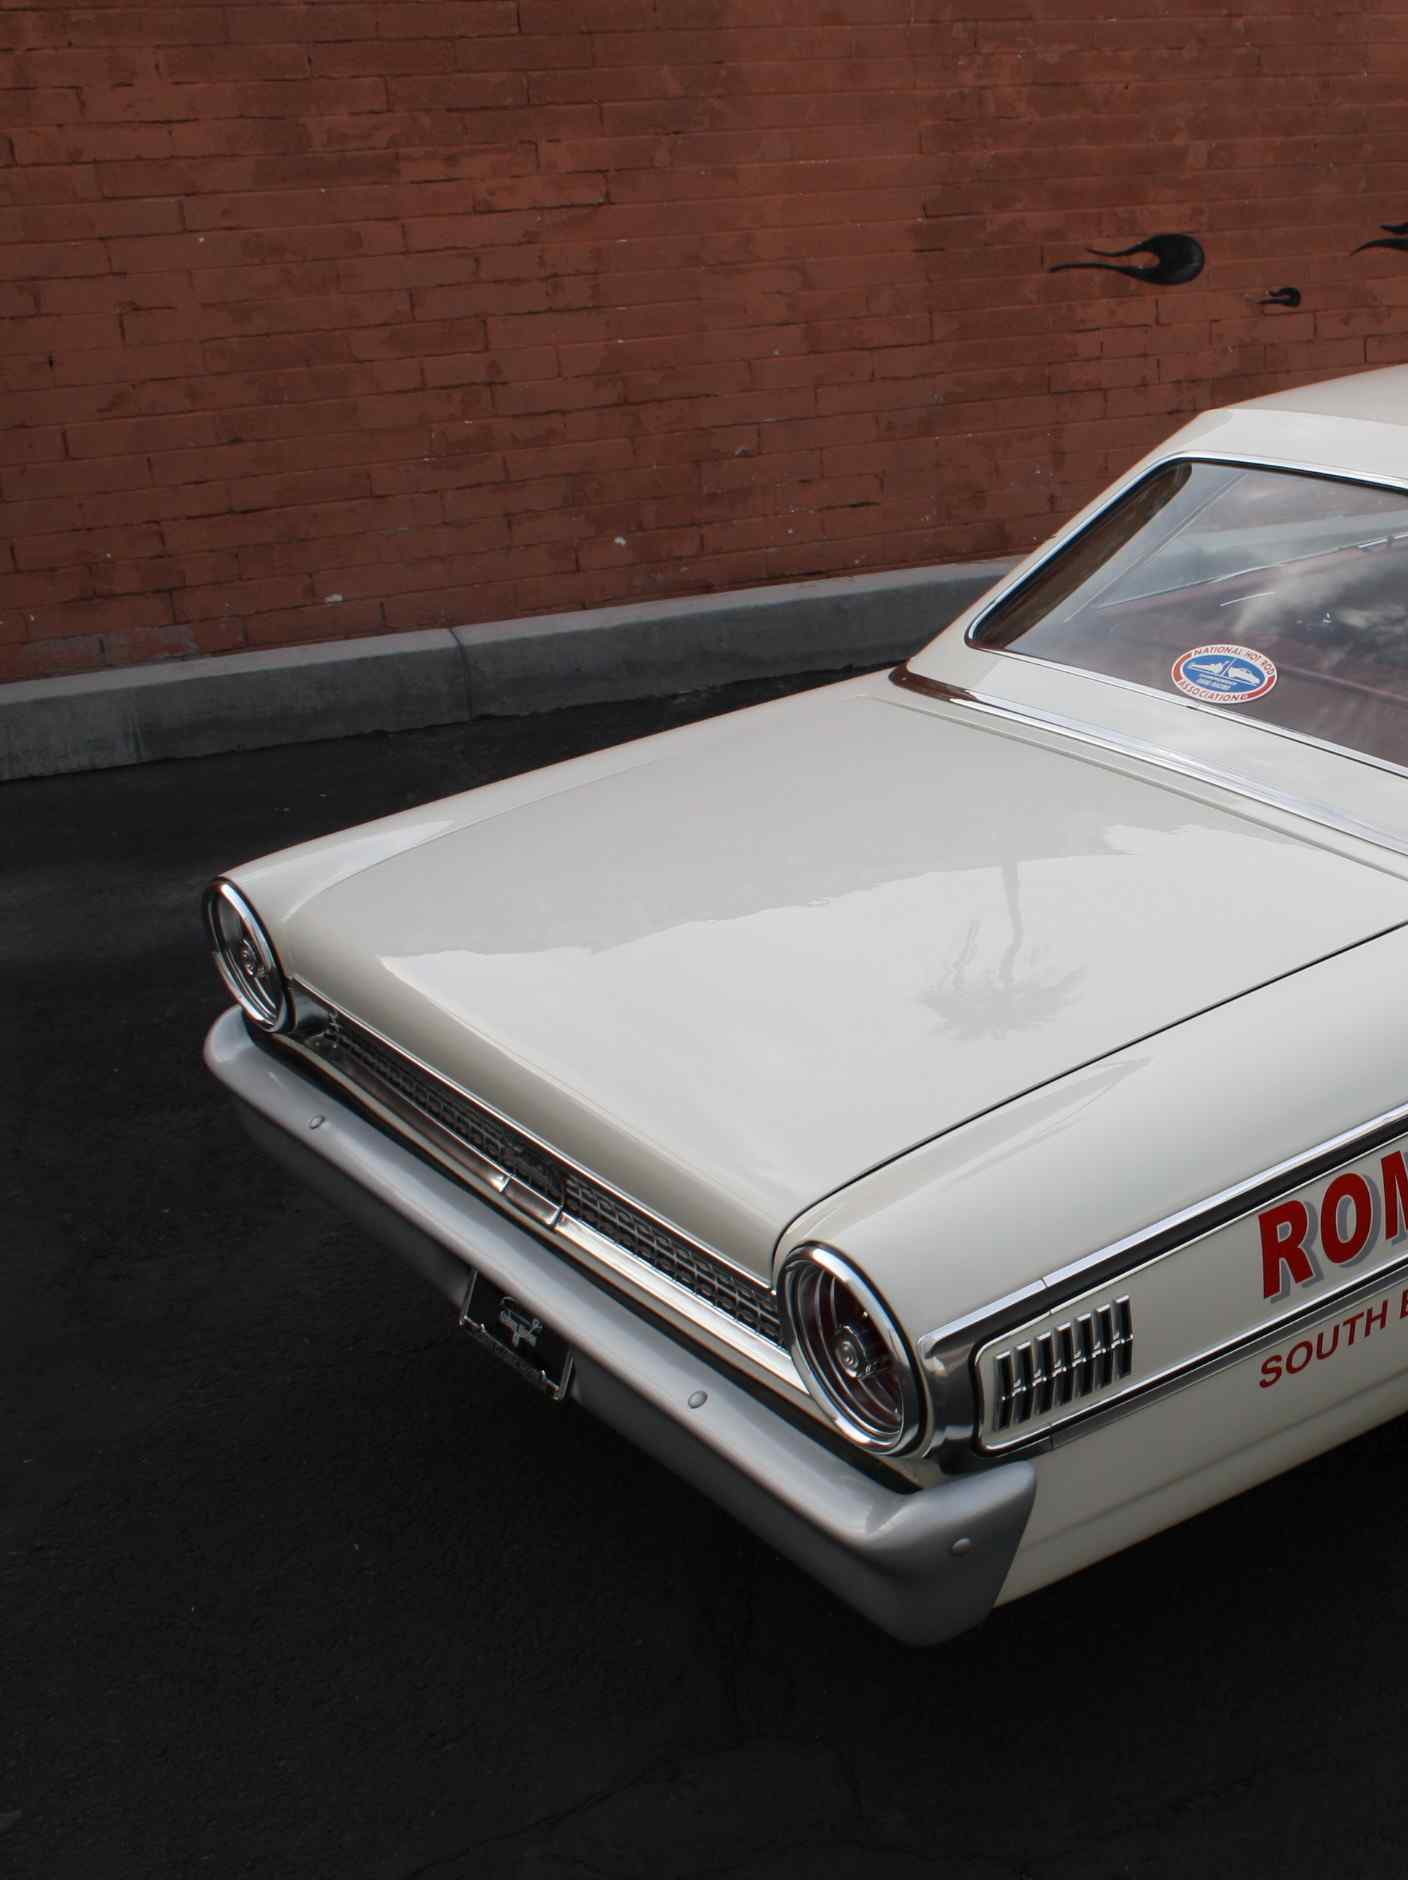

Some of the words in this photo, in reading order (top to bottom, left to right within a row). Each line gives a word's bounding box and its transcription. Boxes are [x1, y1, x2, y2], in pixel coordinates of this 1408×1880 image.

[1193, 646, 1242, 657] NATIONAL
[1178, 679, 1240, 701] ASSOCIATION
[1259, 1300, 1388, 1388] SOUTH
